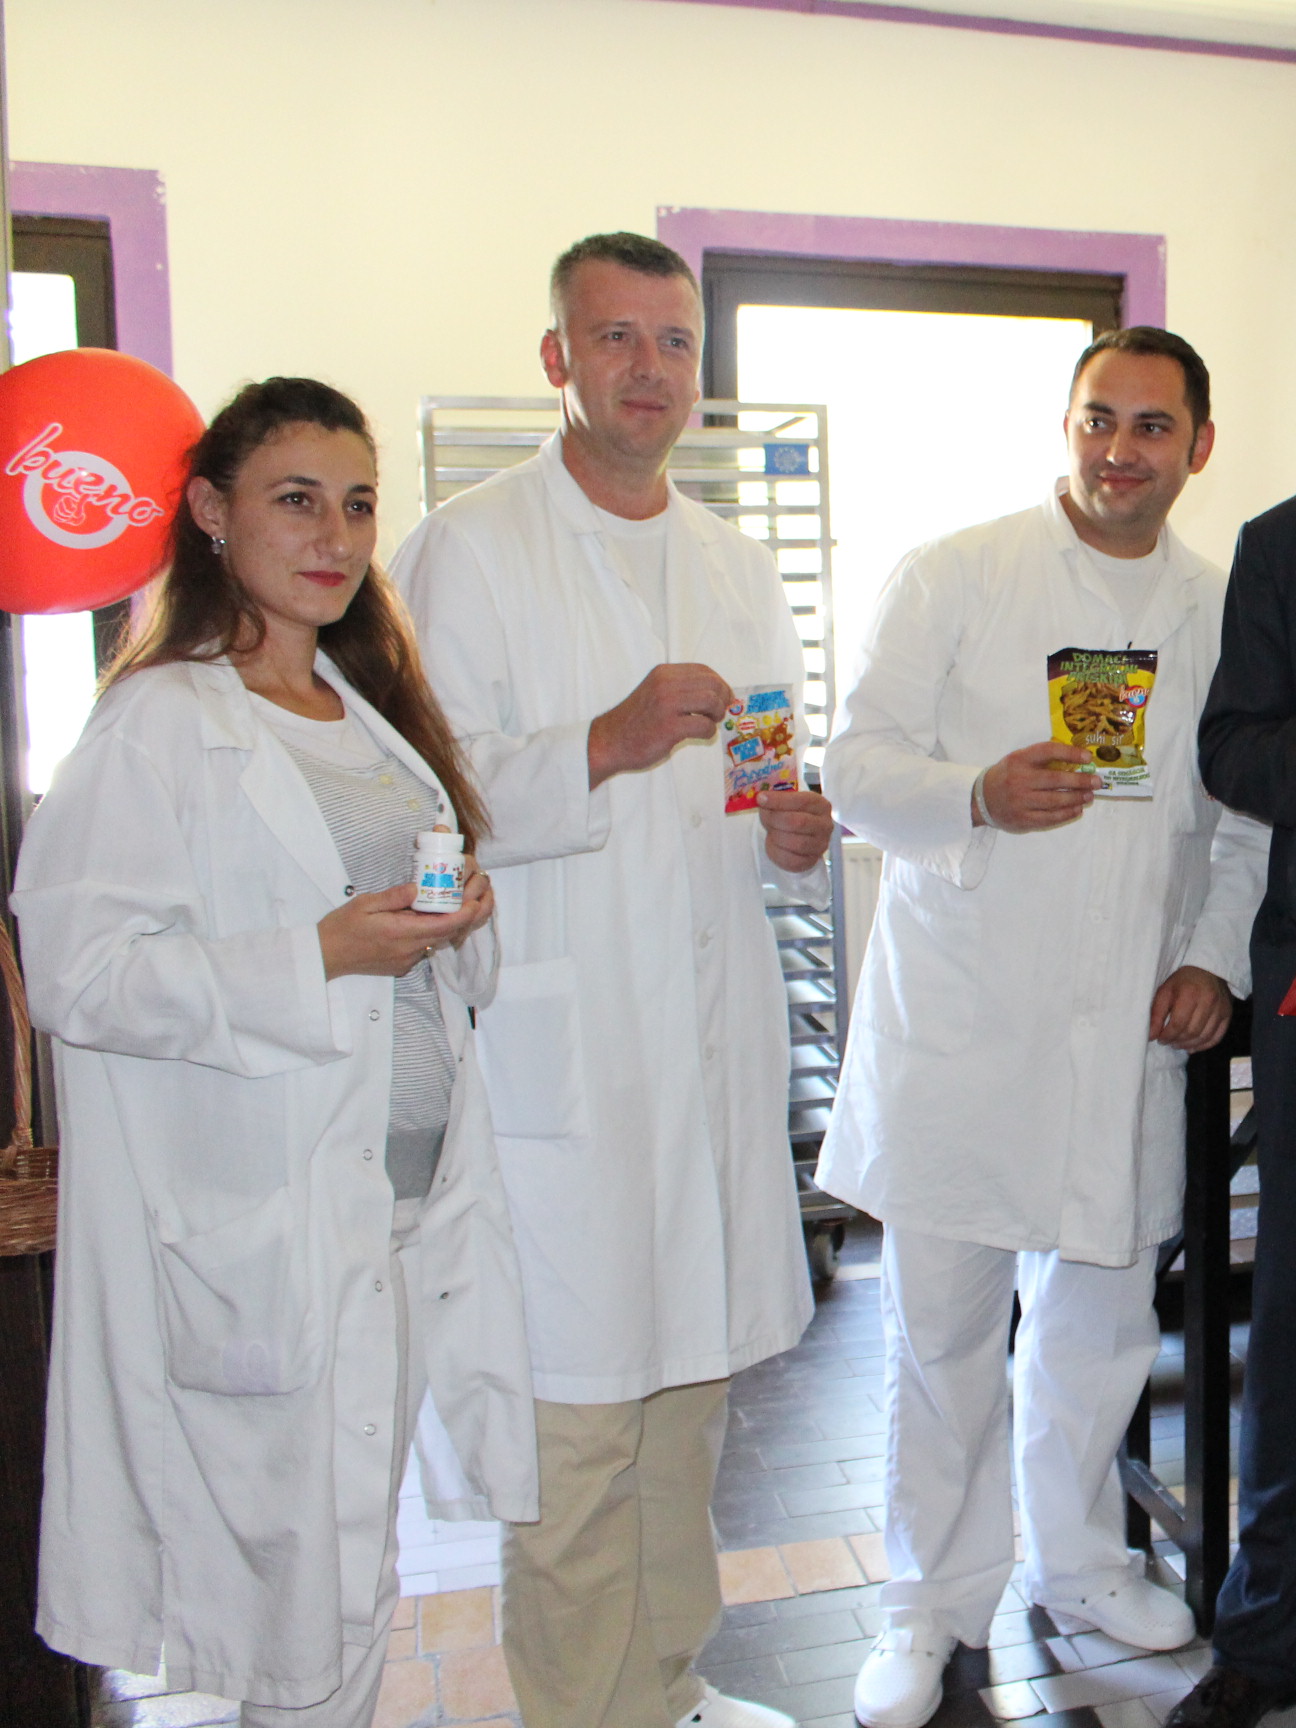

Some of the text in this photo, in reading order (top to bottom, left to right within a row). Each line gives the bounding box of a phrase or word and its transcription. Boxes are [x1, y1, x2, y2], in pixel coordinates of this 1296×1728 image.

[5, 422, 165, 527] bueno
[1085, 732, 1125, 745] suhi sir
